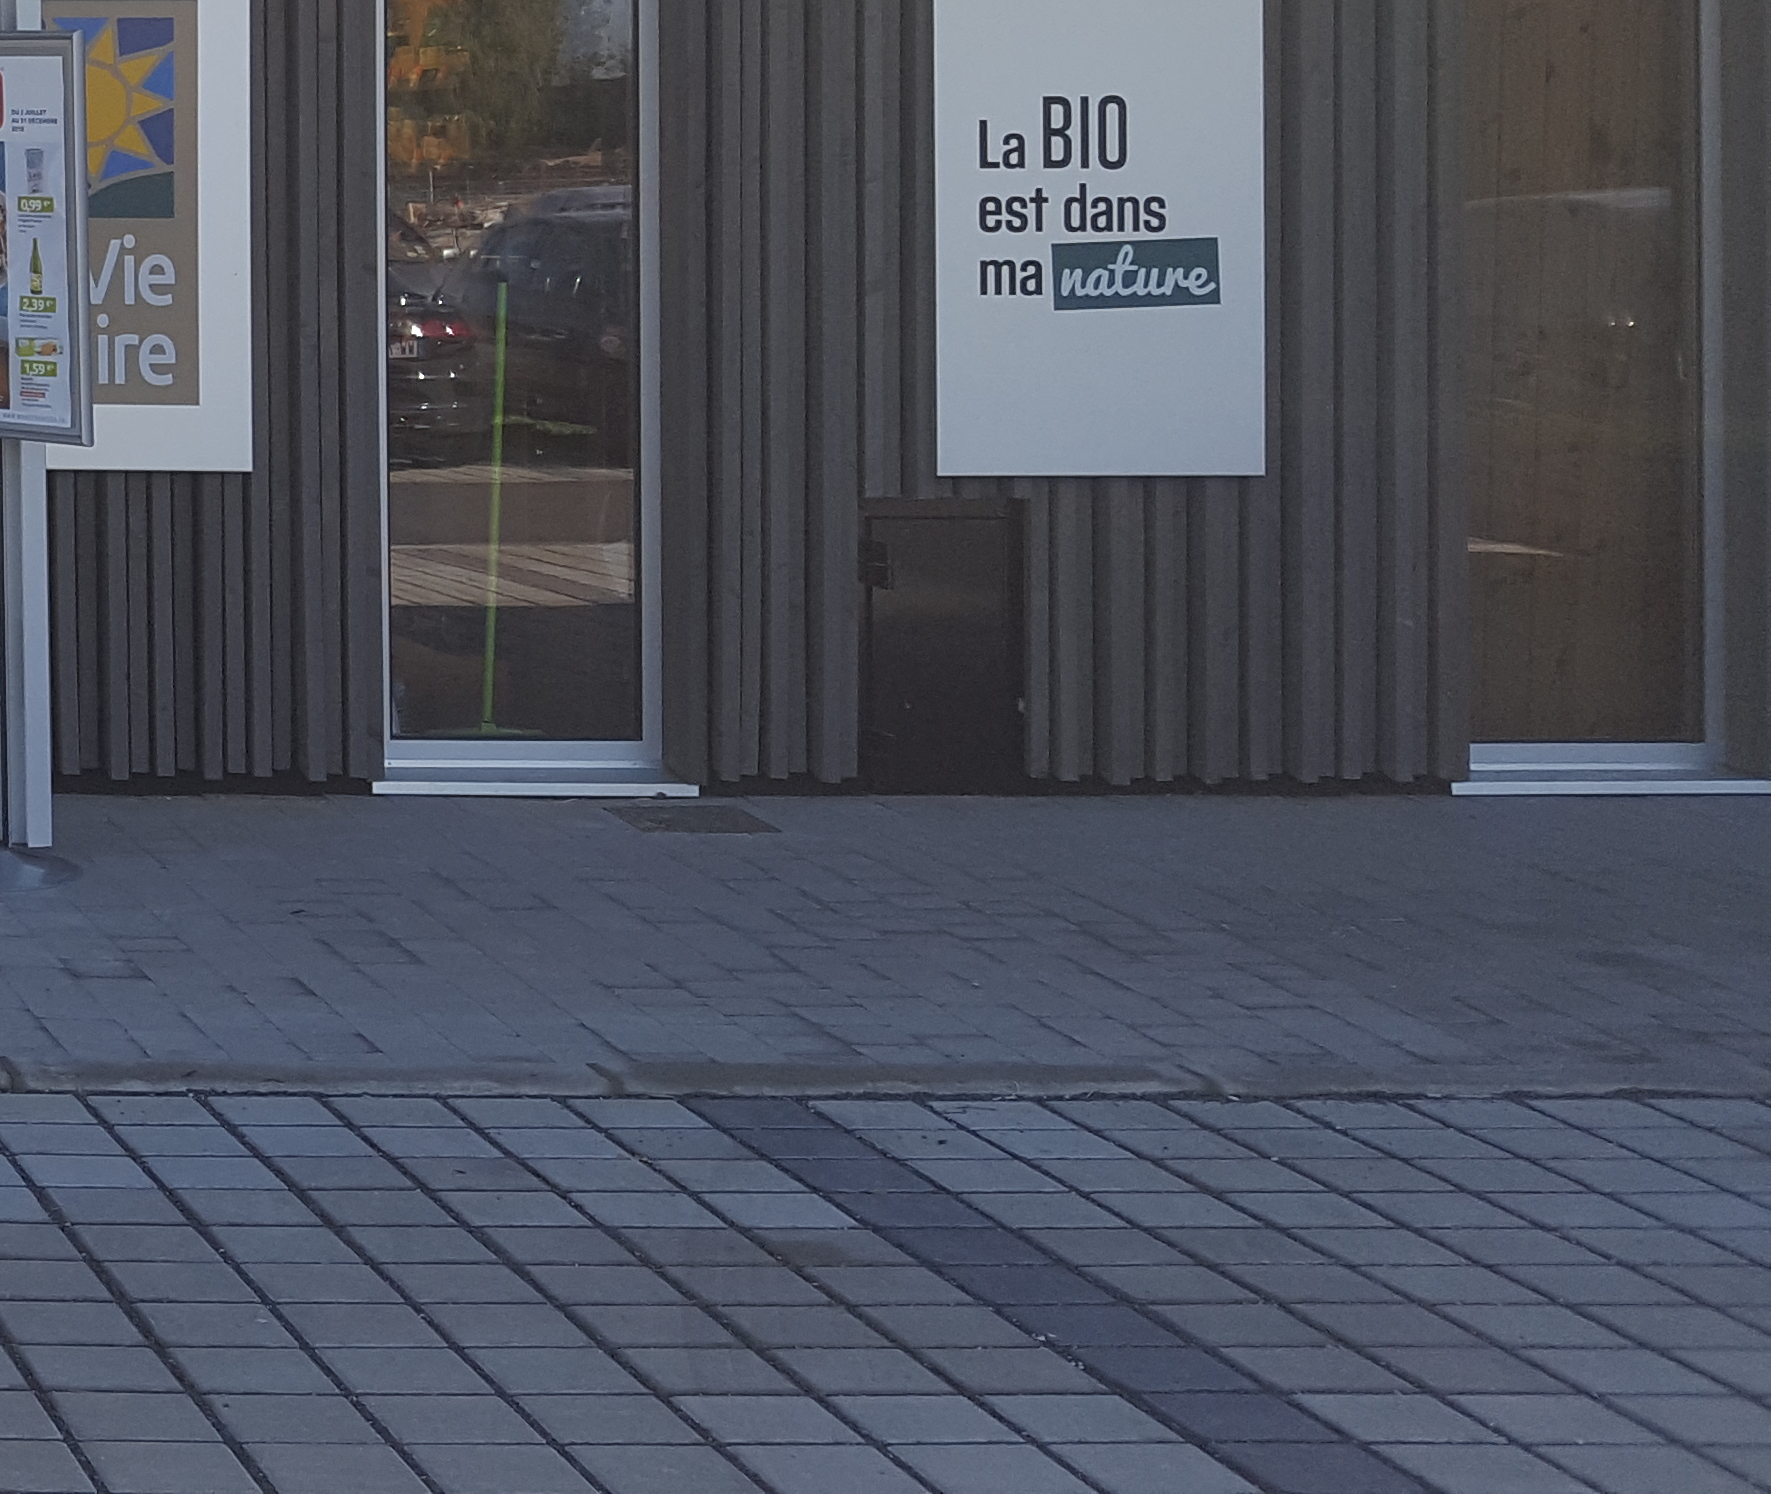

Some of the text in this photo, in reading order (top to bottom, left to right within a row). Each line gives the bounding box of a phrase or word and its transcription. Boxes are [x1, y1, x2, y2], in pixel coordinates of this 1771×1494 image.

[978, 95, 1127, 170] La BIO
[978, 183, 1166, 232] est dans
[90, 234, 175, 307] Vie
[980, 244, 1216, 297] ma nature
[97, 316, 176, 385] ire
